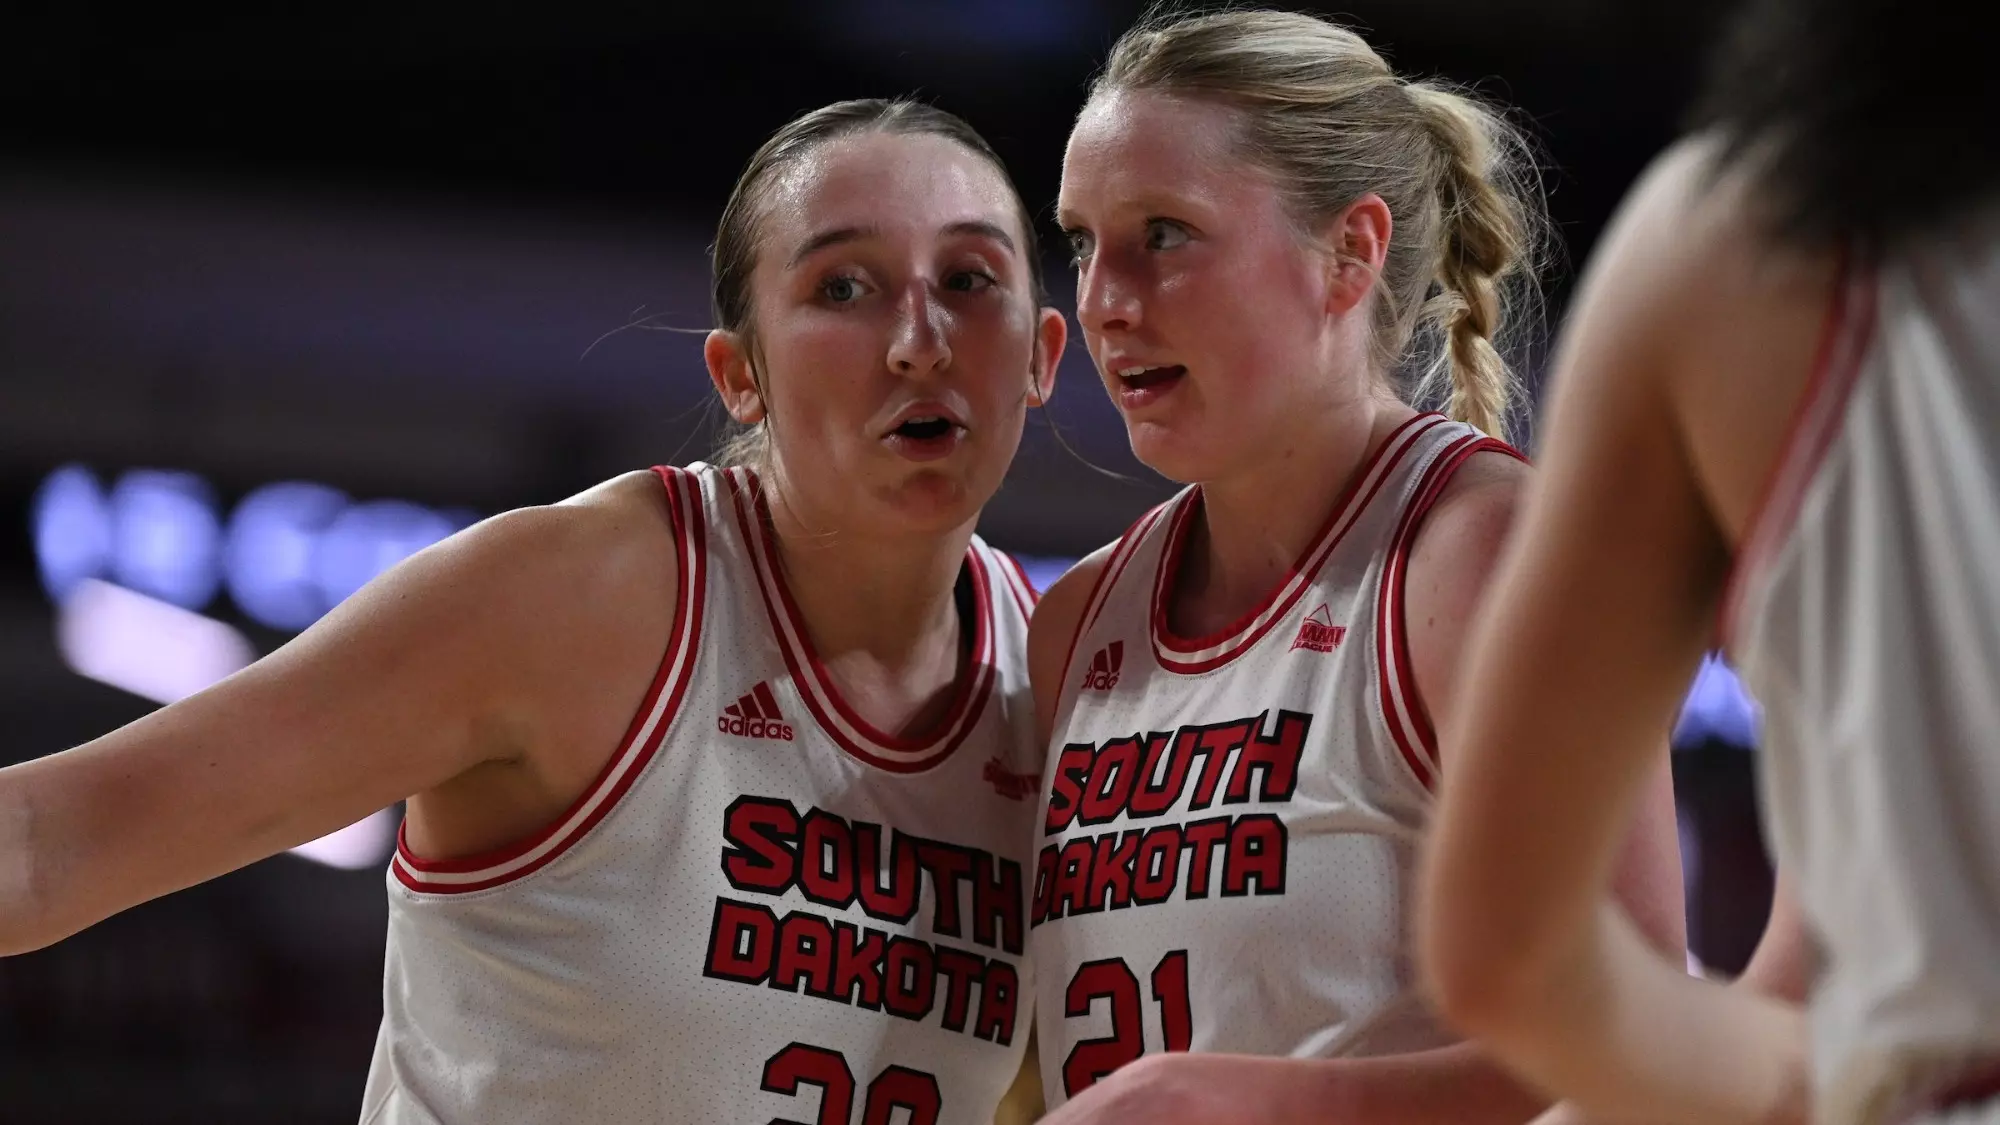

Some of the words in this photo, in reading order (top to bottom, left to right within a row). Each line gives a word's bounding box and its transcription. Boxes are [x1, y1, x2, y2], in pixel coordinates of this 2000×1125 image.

[718, 716, 794, 741] adidas
[1045, 708, 1314, 837] SOUTH
[720, 794, 1024, 956] SOUTH
[1030, 813, 1288, 931] DAKOTA
[702, 895, 1019, 1048] DAKOTA
[1062, 949, 1193, 1101] 21
